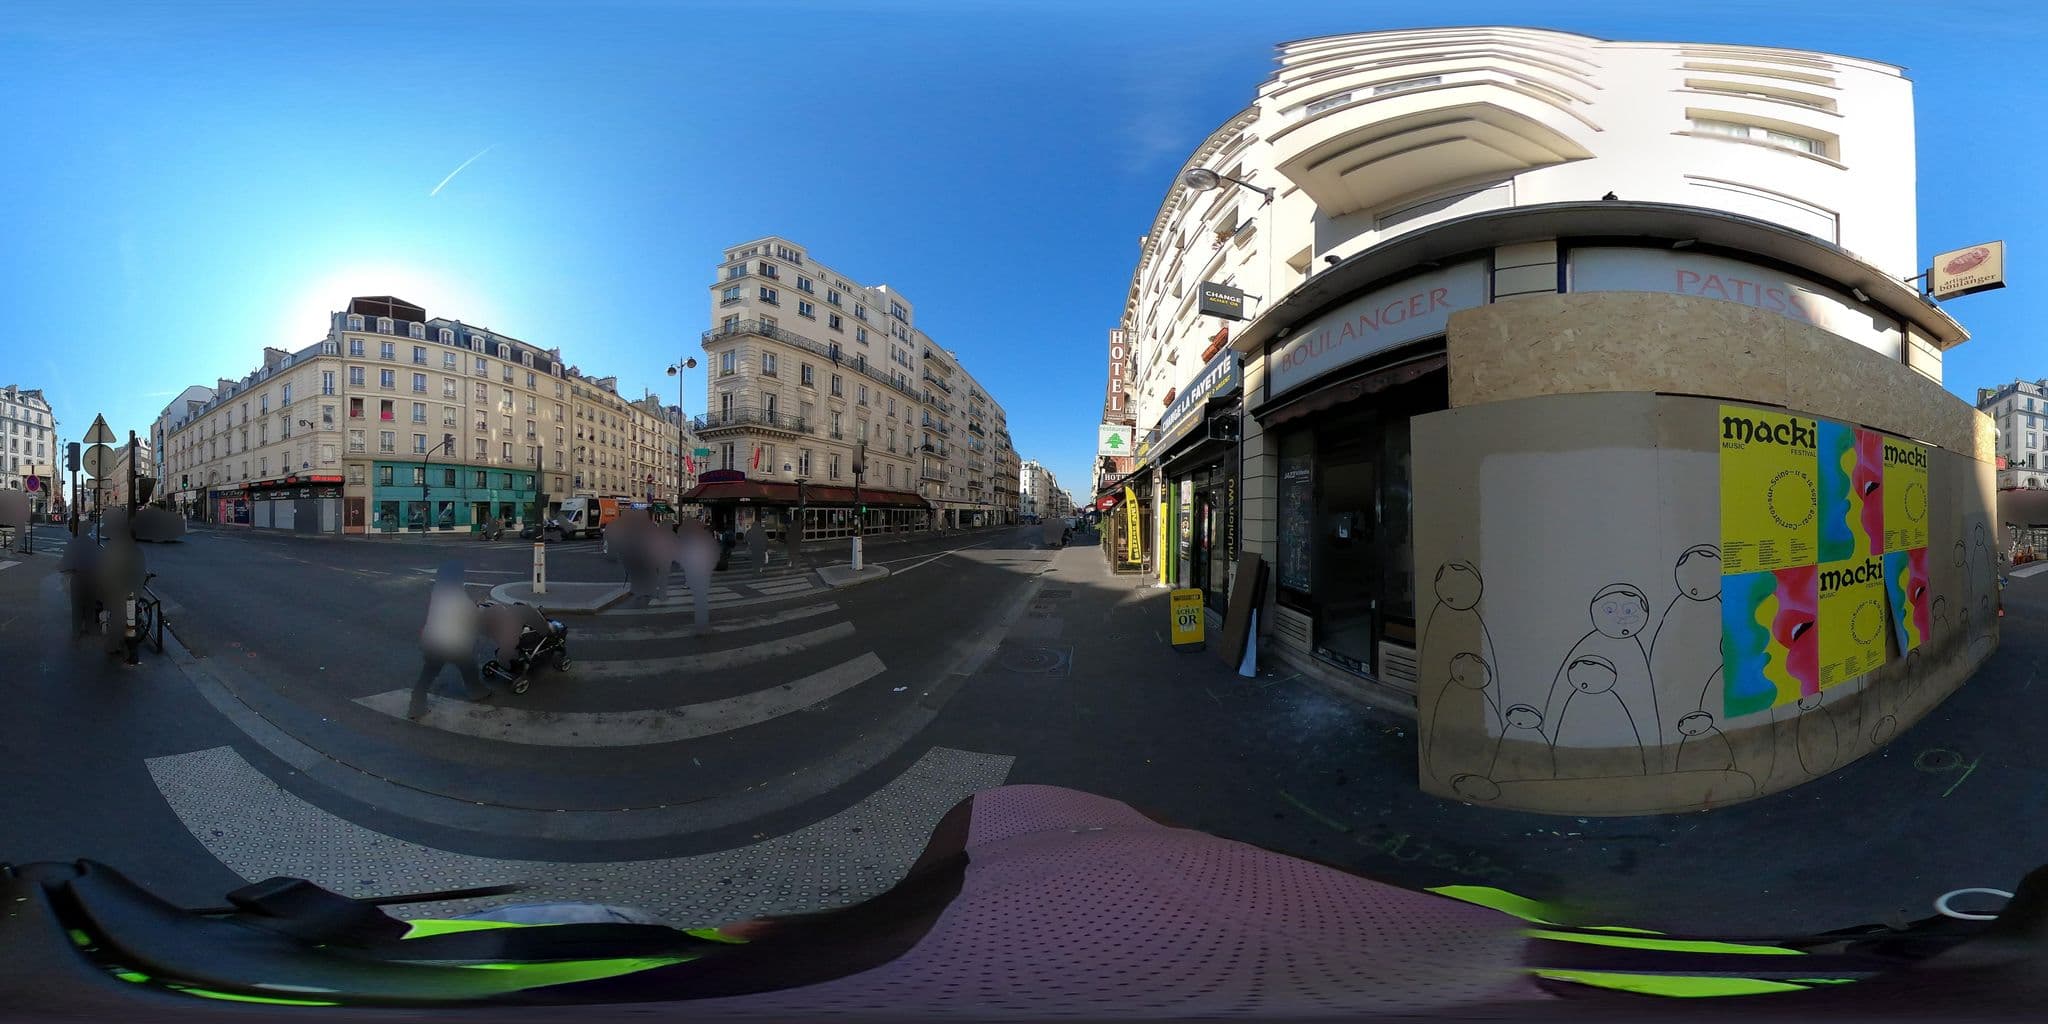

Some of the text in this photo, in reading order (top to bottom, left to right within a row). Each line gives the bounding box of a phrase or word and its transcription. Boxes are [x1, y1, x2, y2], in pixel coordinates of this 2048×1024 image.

[1939, 274, 1997, 292] boulanger
[1944, 275, 1974, 286] artisan
[1205, 290, 1242, 303] CHANGE
[1281, 287, 1456, 374] BOULANGER
[1111, 330, 1123, 412] HOTEL
[1162, 404, 1182, 432] CHANGE
[1181, 395, 1191, 413] LA
[1191, 354, 1231, 404] FAYETTE
[1723, 417, 1817, 449] macki
[1722, 442, 1746, 450] MUSIC
[1791, 449, 1817, 458] FESTIVAL
[1884, 445, 1927, 468] macki
[1820, 556, 1883, 592] macki
[1176, 607, 1200, 616] ACHAT
[1179, 615, 1197, 625] OR
